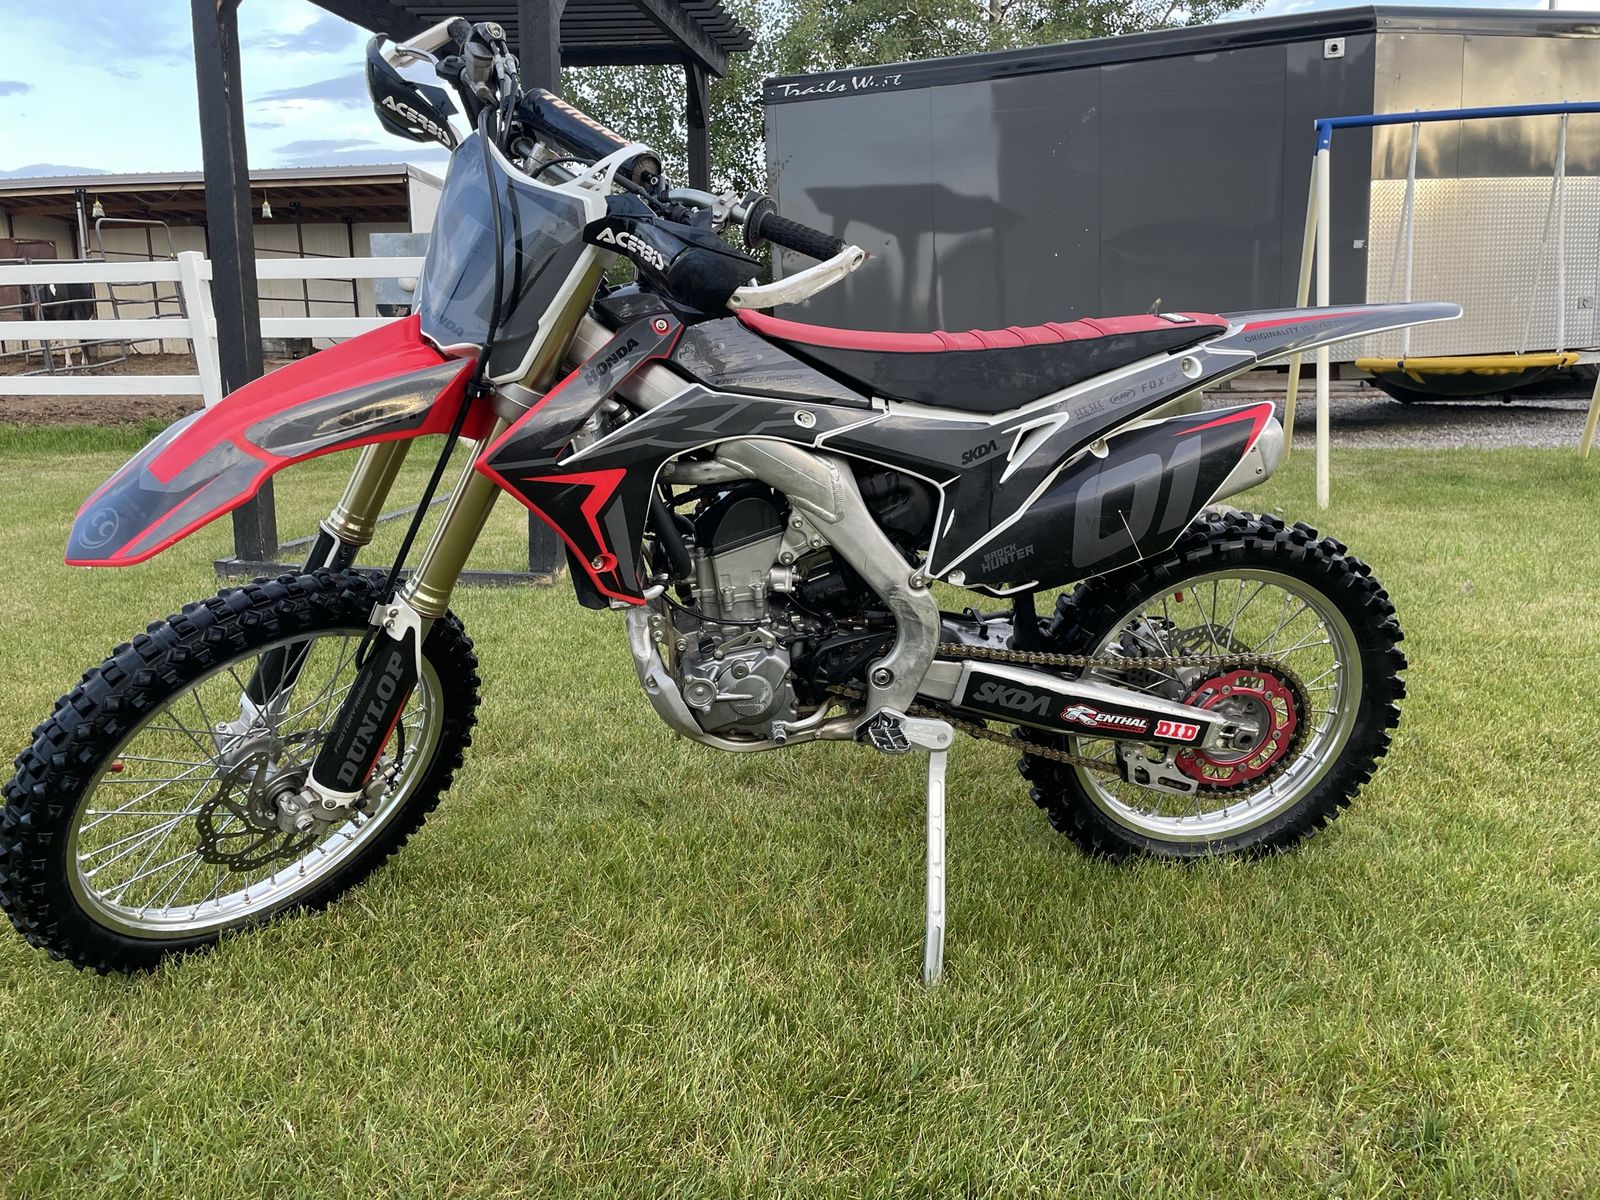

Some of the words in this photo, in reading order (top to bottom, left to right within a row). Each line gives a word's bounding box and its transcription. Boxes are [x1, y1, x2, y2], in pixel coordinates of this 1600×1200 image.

[777, 80, 848, 97] Trails
[1244, 326, 1299, 344] ORIGINALITY
[583, 337, 640, 387] HONDA
[981, 544, 1035, 573] HUNTER
[336, 651, 405, 786] DUNLOP
[1061, 704, 1148, 729] RENTHAL
